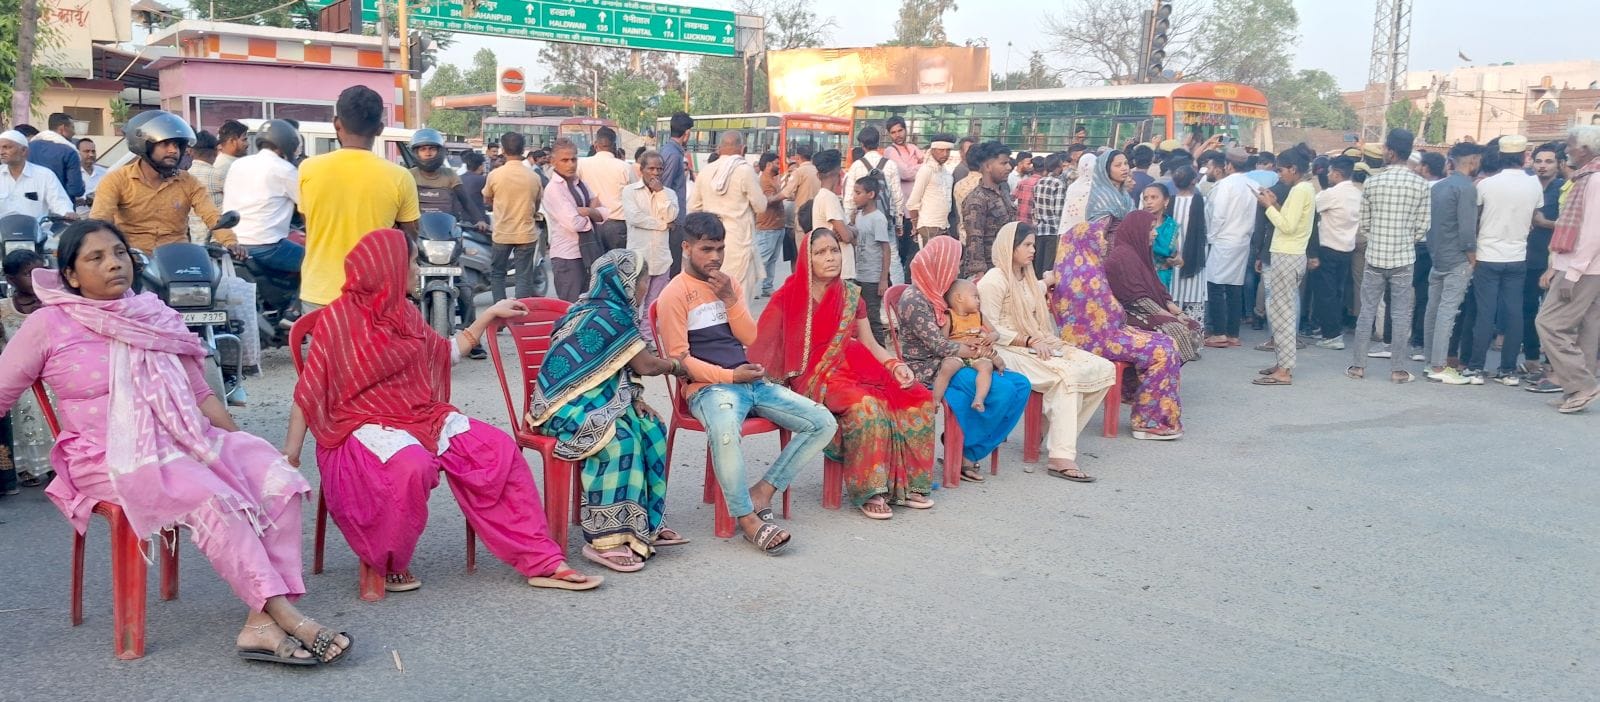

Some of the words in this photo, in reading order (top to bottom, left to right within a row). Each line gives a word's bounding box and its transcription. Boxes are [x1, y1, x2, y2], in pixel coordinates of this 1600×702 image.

[450, 9, 512, 22] SHAHANPUR
[548, 20, 587, 30] HALDWANI
[622, 27, 653, 37] NAINITAL
[683, 33, 717, 42] LUCKNOW
[202, 313, 224, 321] 7375
